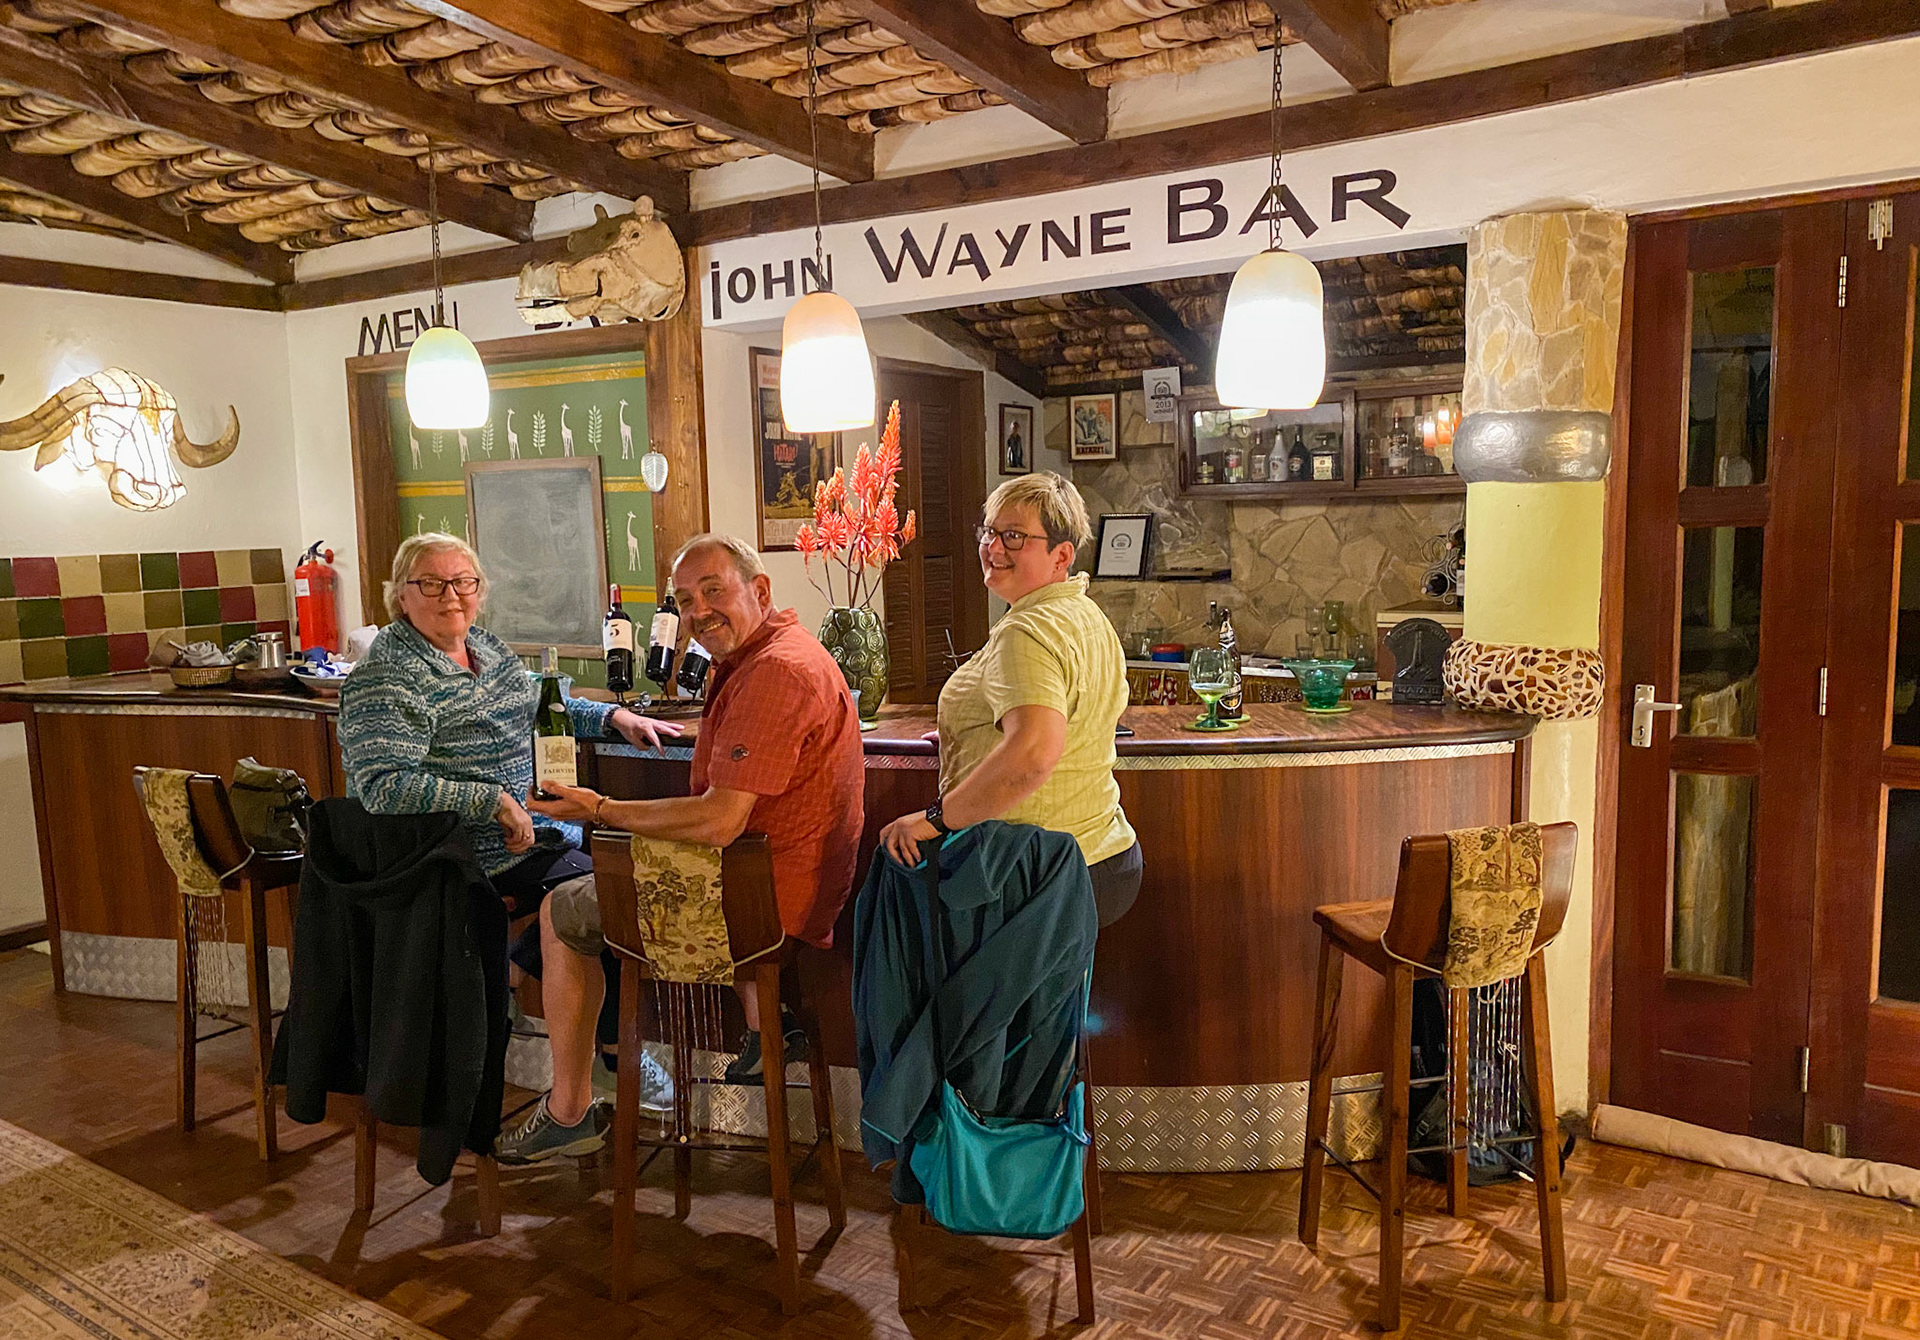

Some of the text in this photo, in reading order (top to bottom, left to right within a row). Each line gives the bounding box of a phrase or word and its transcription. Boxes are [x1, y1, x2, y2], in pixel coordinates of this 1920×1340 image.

[711, 169, 1411, 320] JOHN WAYNE BAR
[1155, 400, 1172, 409] 2013
[609, 623, 620, 637] 5
